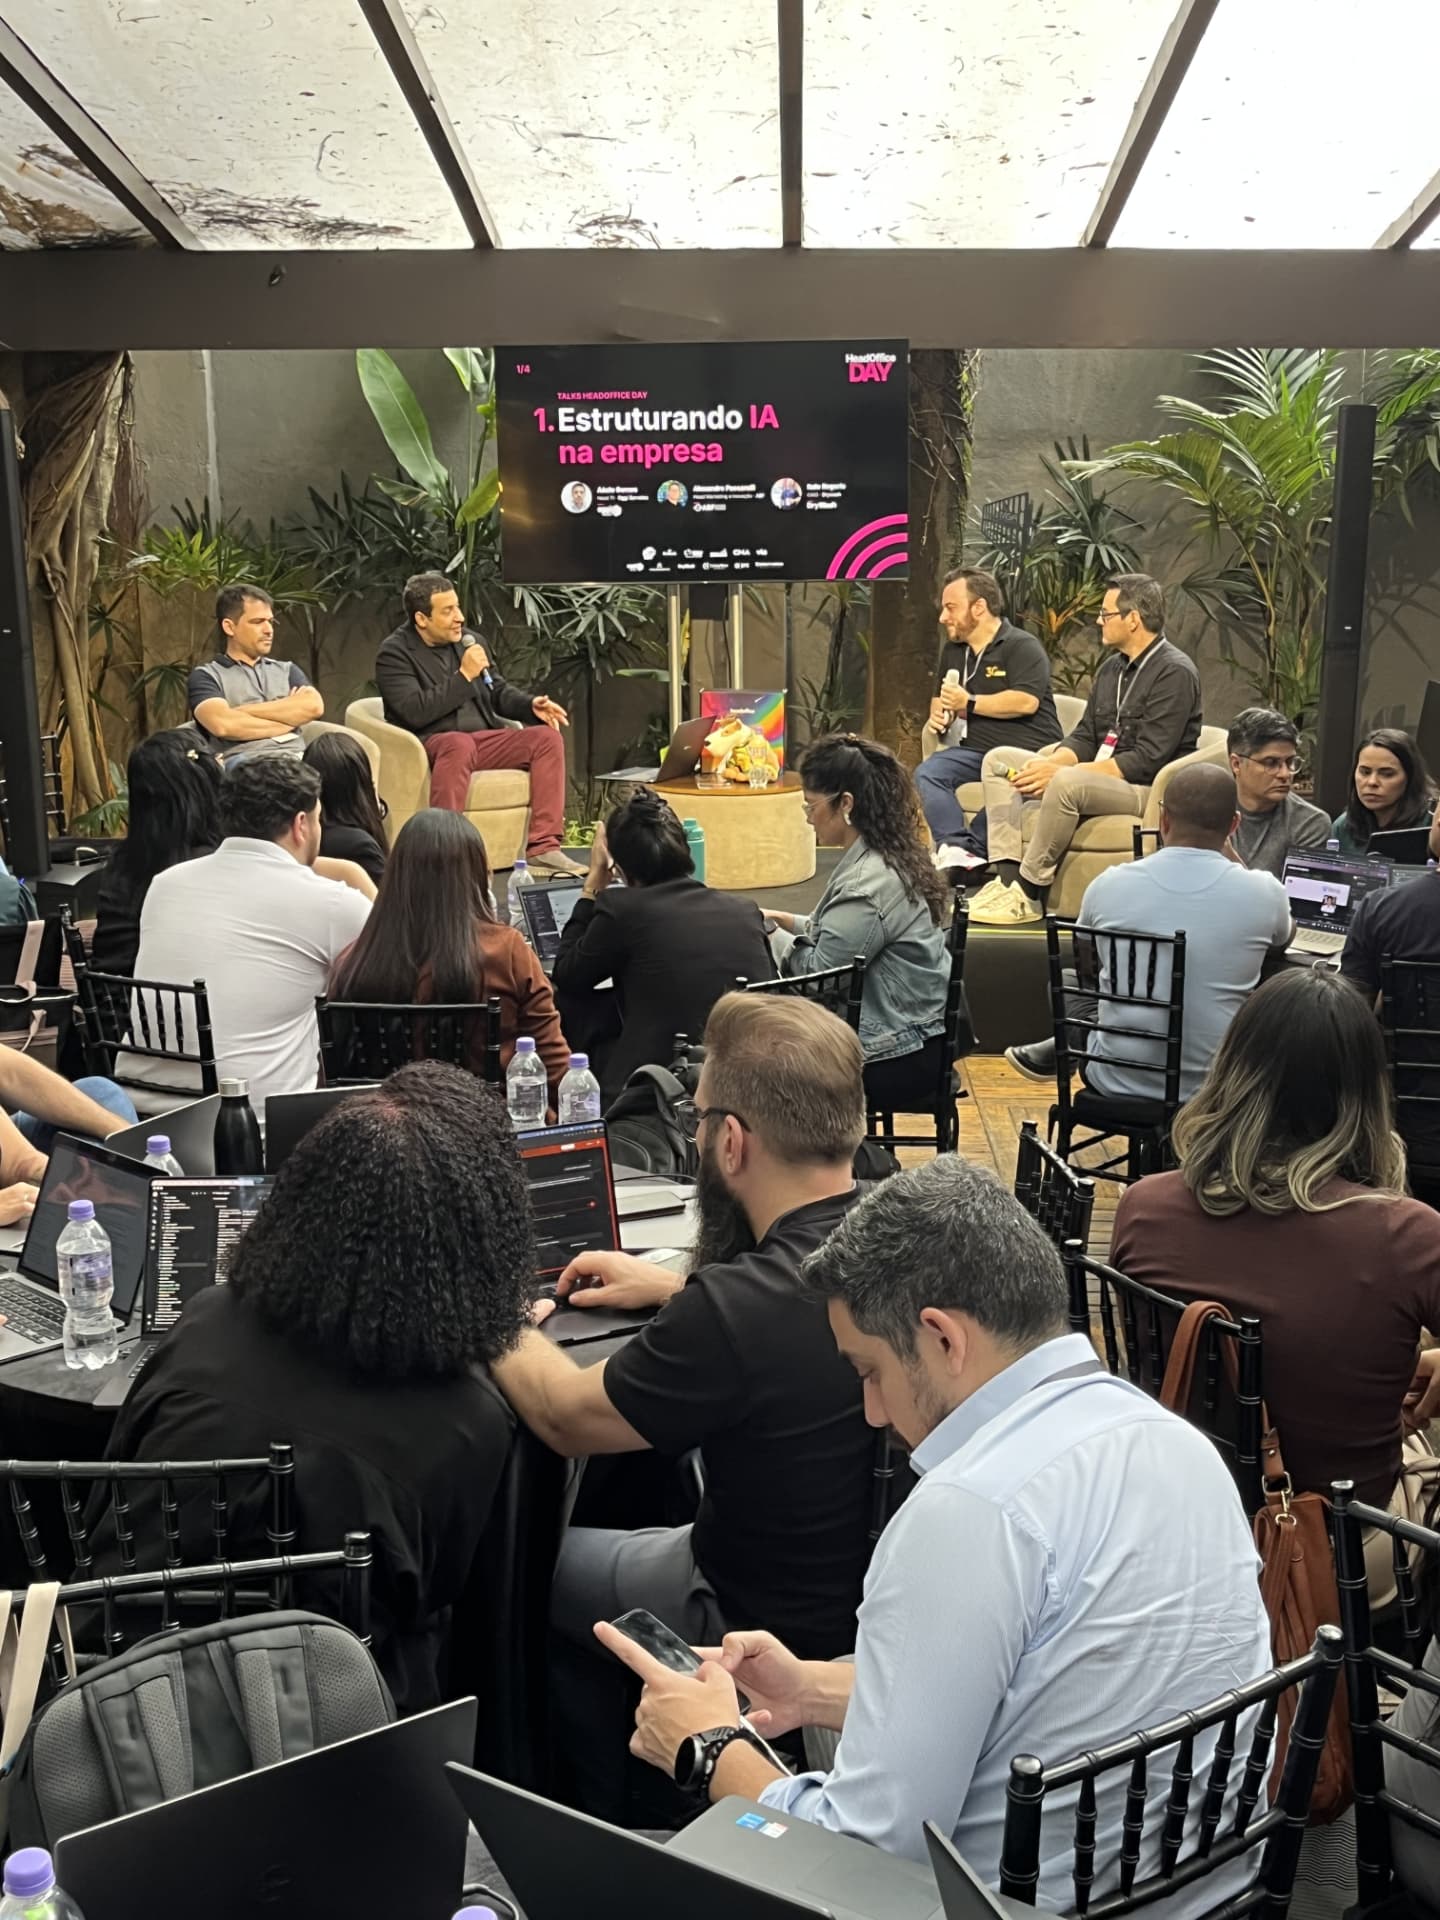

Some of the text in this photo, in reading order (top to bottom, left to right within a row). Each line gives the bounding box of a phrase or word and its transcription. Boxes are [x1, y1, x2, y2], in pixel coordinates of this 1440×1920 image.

[516, 364, 531, 374] 1/4
[848, 362, 892, 383] DAY
[557, 391, 648, 400] TALKS HEADOFFICE DAY
[533, 404, 780, 432] 1. Estruturando IA
[559, 442, 723, 469] na empresa
